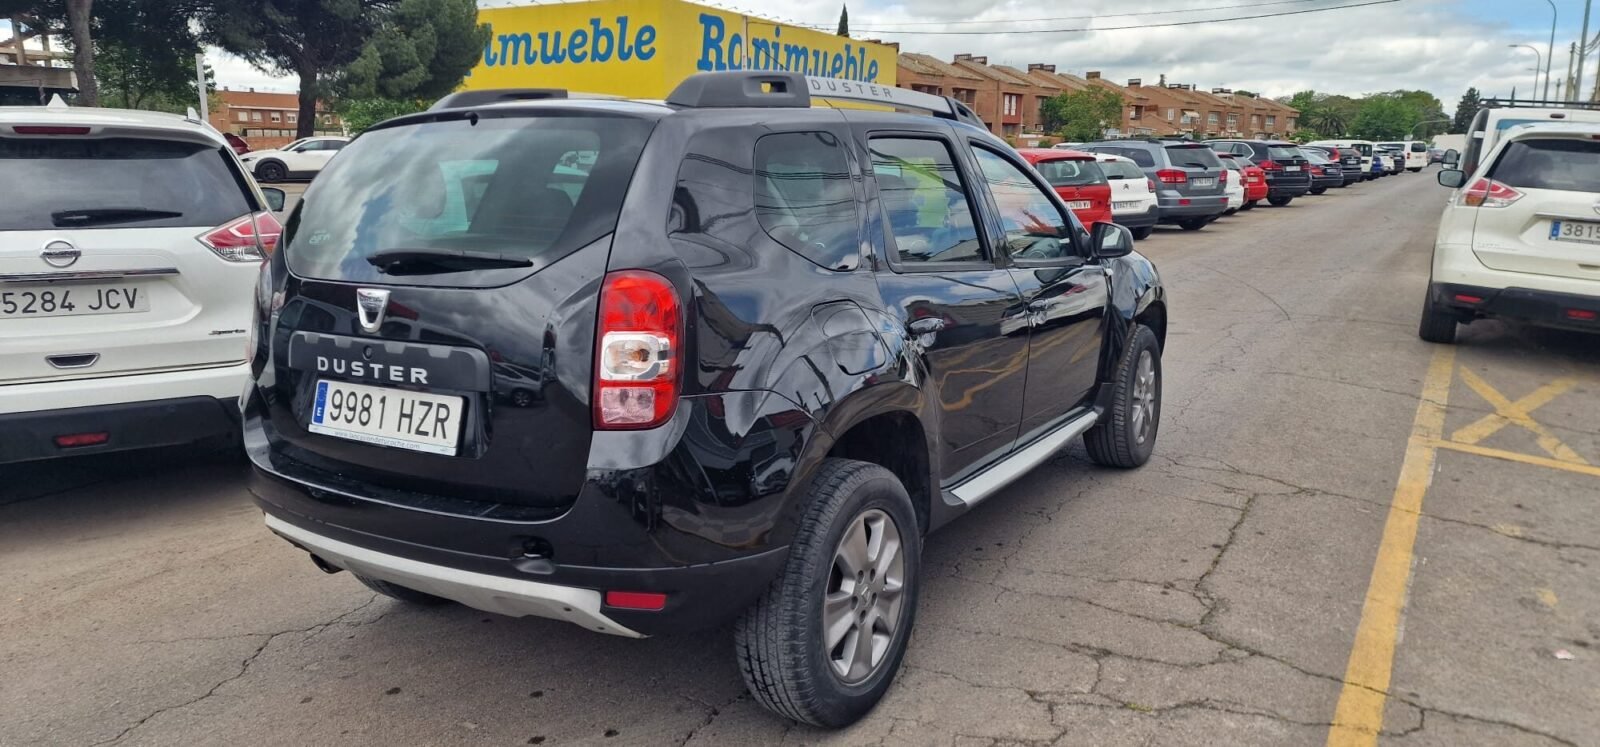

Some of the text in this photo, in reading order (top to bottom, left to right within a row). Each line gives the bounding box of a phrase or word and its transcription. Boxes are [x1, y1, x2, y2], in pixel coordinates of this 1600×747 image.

[811, 79, 894, 98] DUSTER
[2, 288, 138, 314] 5284 JCV
[317, 356, 429, 384] DUSTER
[316, 406, 323, 417] E
[329, 388, 450, 440] 9981 HZR
